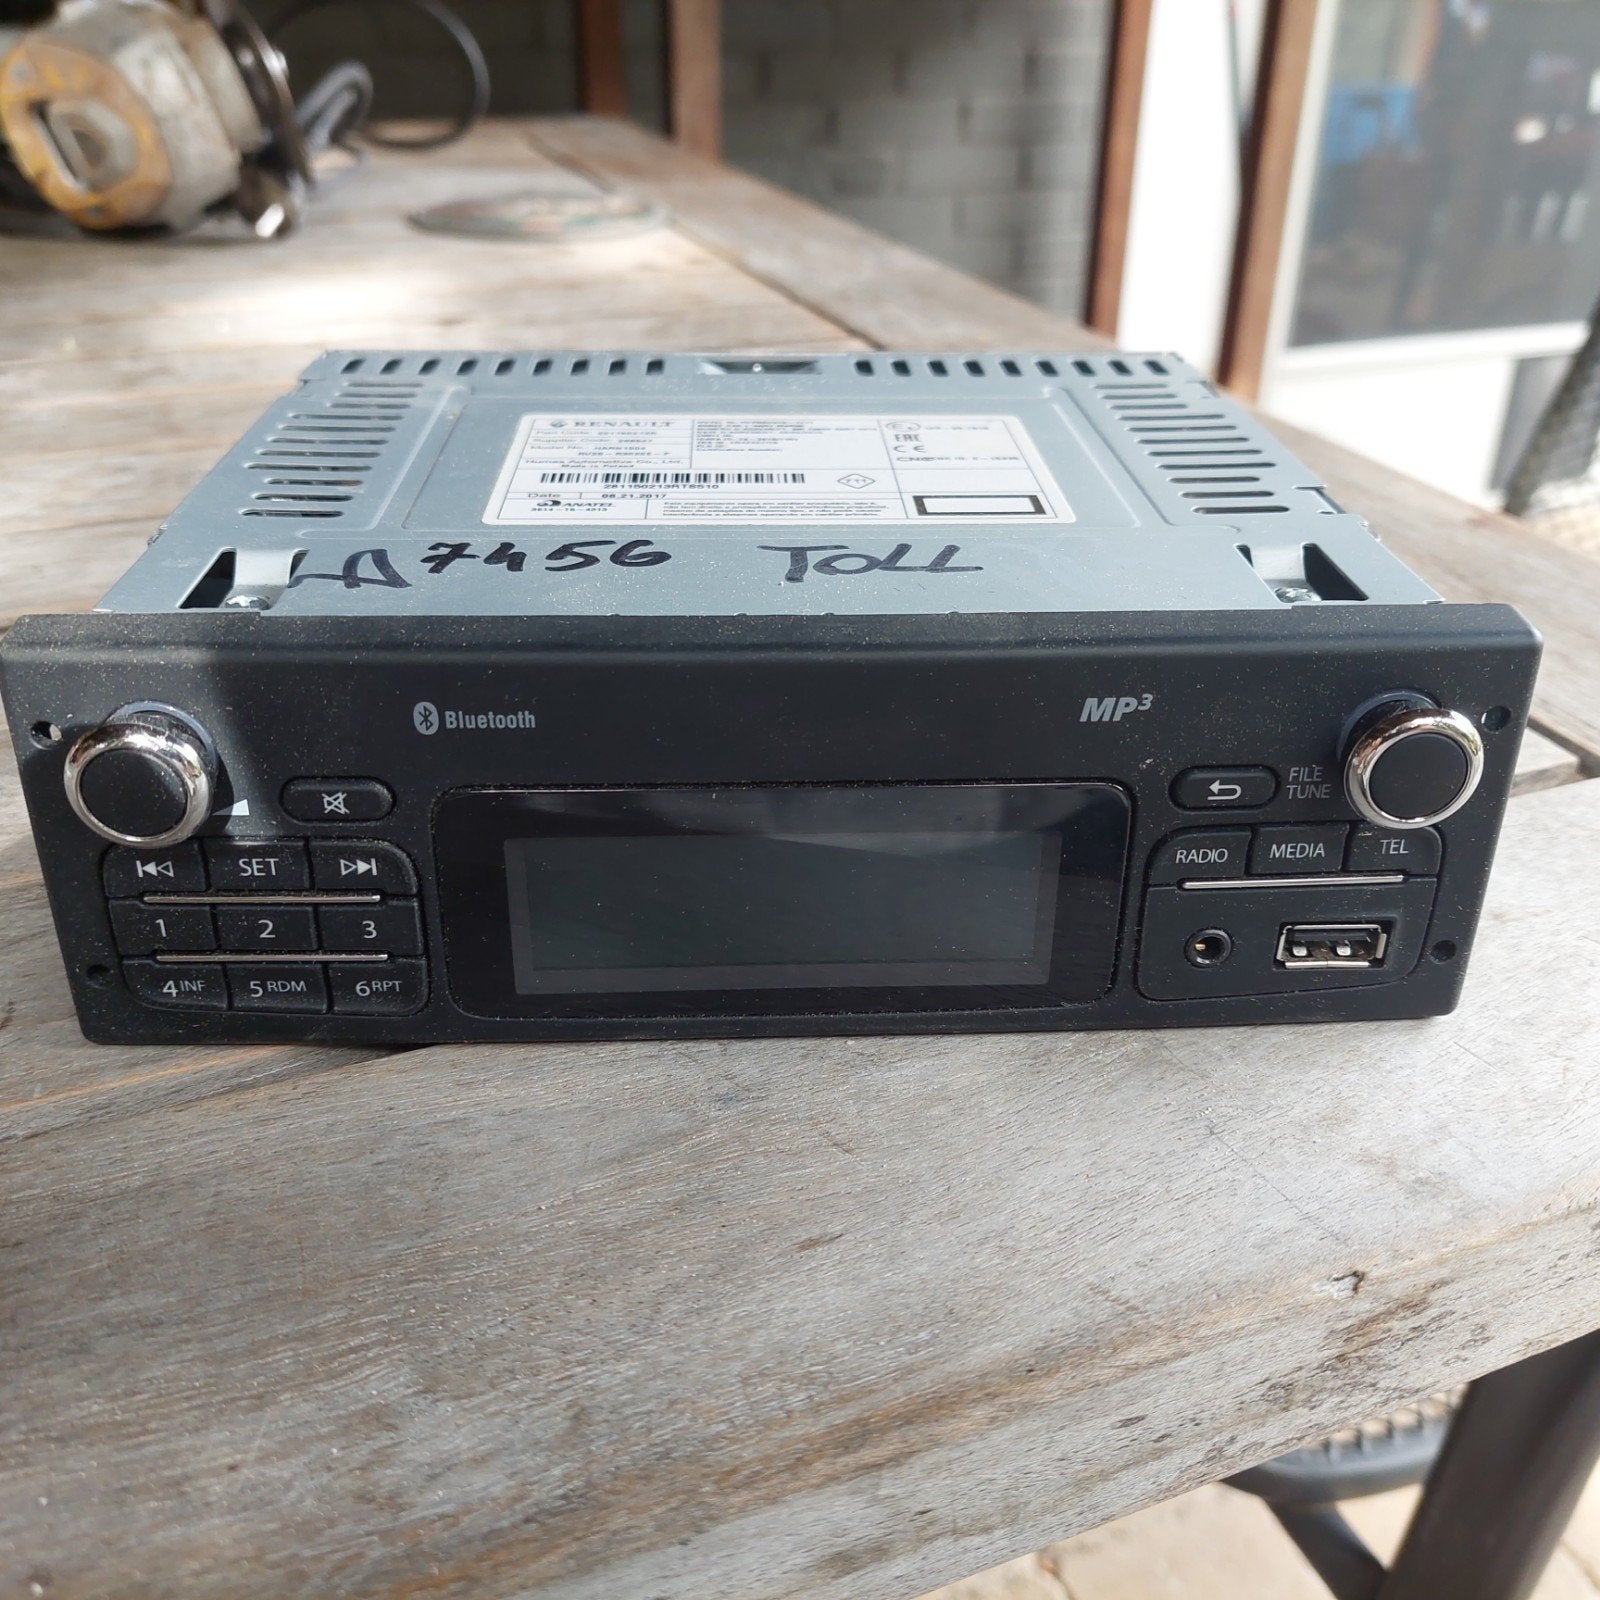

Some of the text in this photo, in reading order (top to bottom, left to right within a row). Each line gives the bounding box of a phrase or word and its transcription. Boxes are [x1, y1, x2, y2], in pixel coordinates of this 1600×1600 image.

[757, 542, 984, 583] TOLL
[1079, 692, 1153, 723] MP3
[445, 710, 536, 729] Bluetooth
[1289, 766, 1323, 781] FILE
[1286, 784, 1331, 800] TUNE
[1270, 842, 1325, 859] MEDIA
[1380, 838, 1409, 855] TEL
[1175, 848, 1228, 864] RADIO
[238, 858, 279, 876] SET
[155, 919, 167, 937] 1
[258, 919, 276, 938] 2
[364, 920, 377, 939] 3
